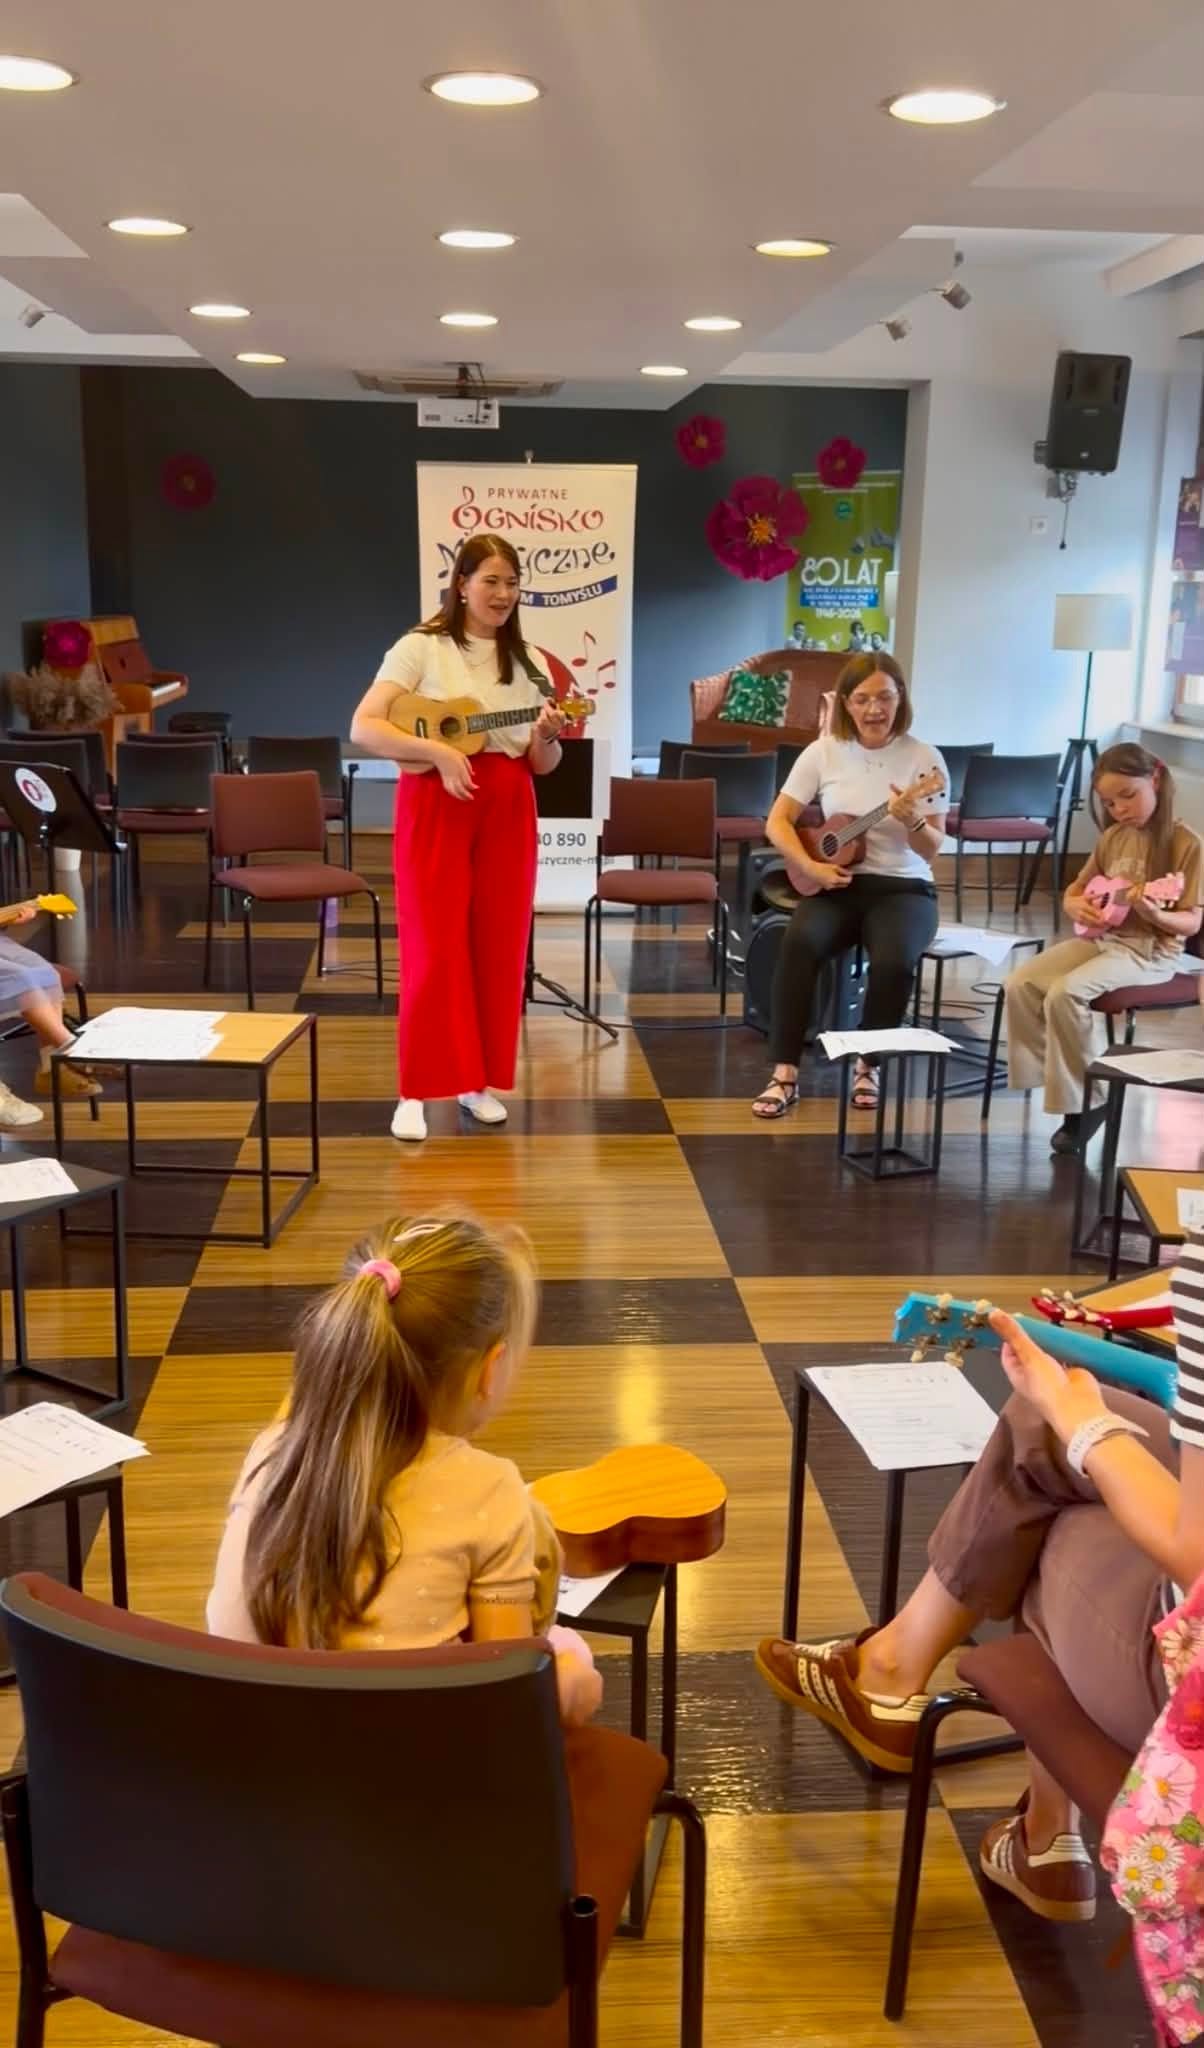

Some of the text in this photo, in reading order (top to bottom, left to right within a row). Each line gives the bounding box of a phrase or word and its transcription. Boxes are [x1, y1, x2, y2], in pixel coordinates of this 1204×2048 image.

[487, 486, 569, 501] PRYWATNE
[801, 557, 883, 586] 80 LAT
[557, 832, 586, 847] 890
